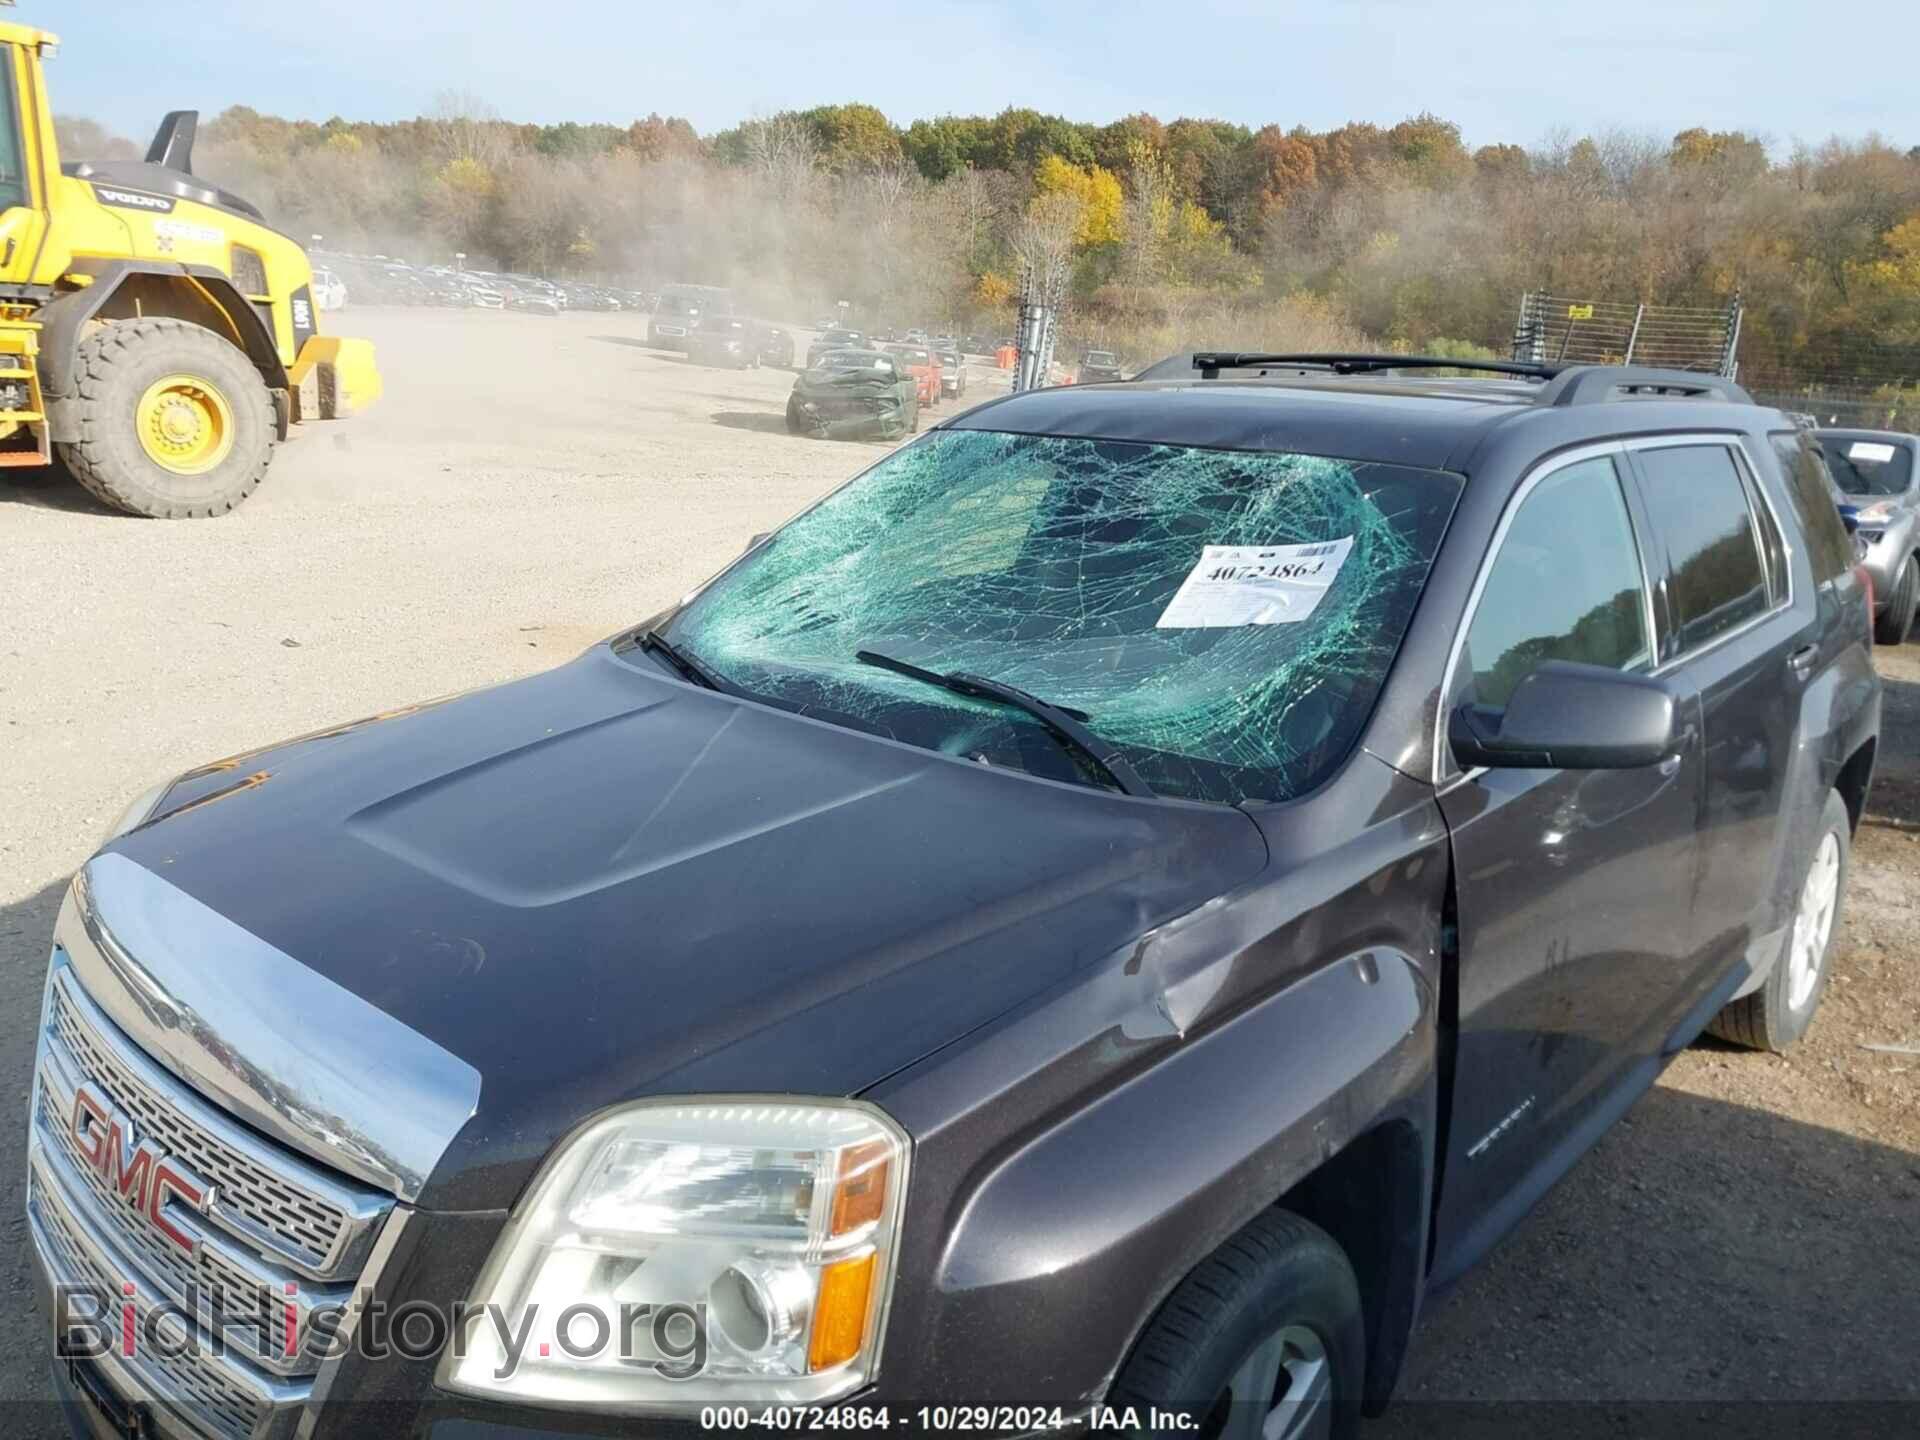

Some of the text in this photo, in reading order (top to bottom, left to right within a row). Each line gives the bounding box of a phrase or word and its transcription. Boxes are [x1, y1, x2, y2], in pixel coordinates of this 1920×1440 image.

[97, 188, 171, 210] VOLVO
[1206, 560, 1326, 582] 40724864
[71, 1084, 207, 1258] GMC
